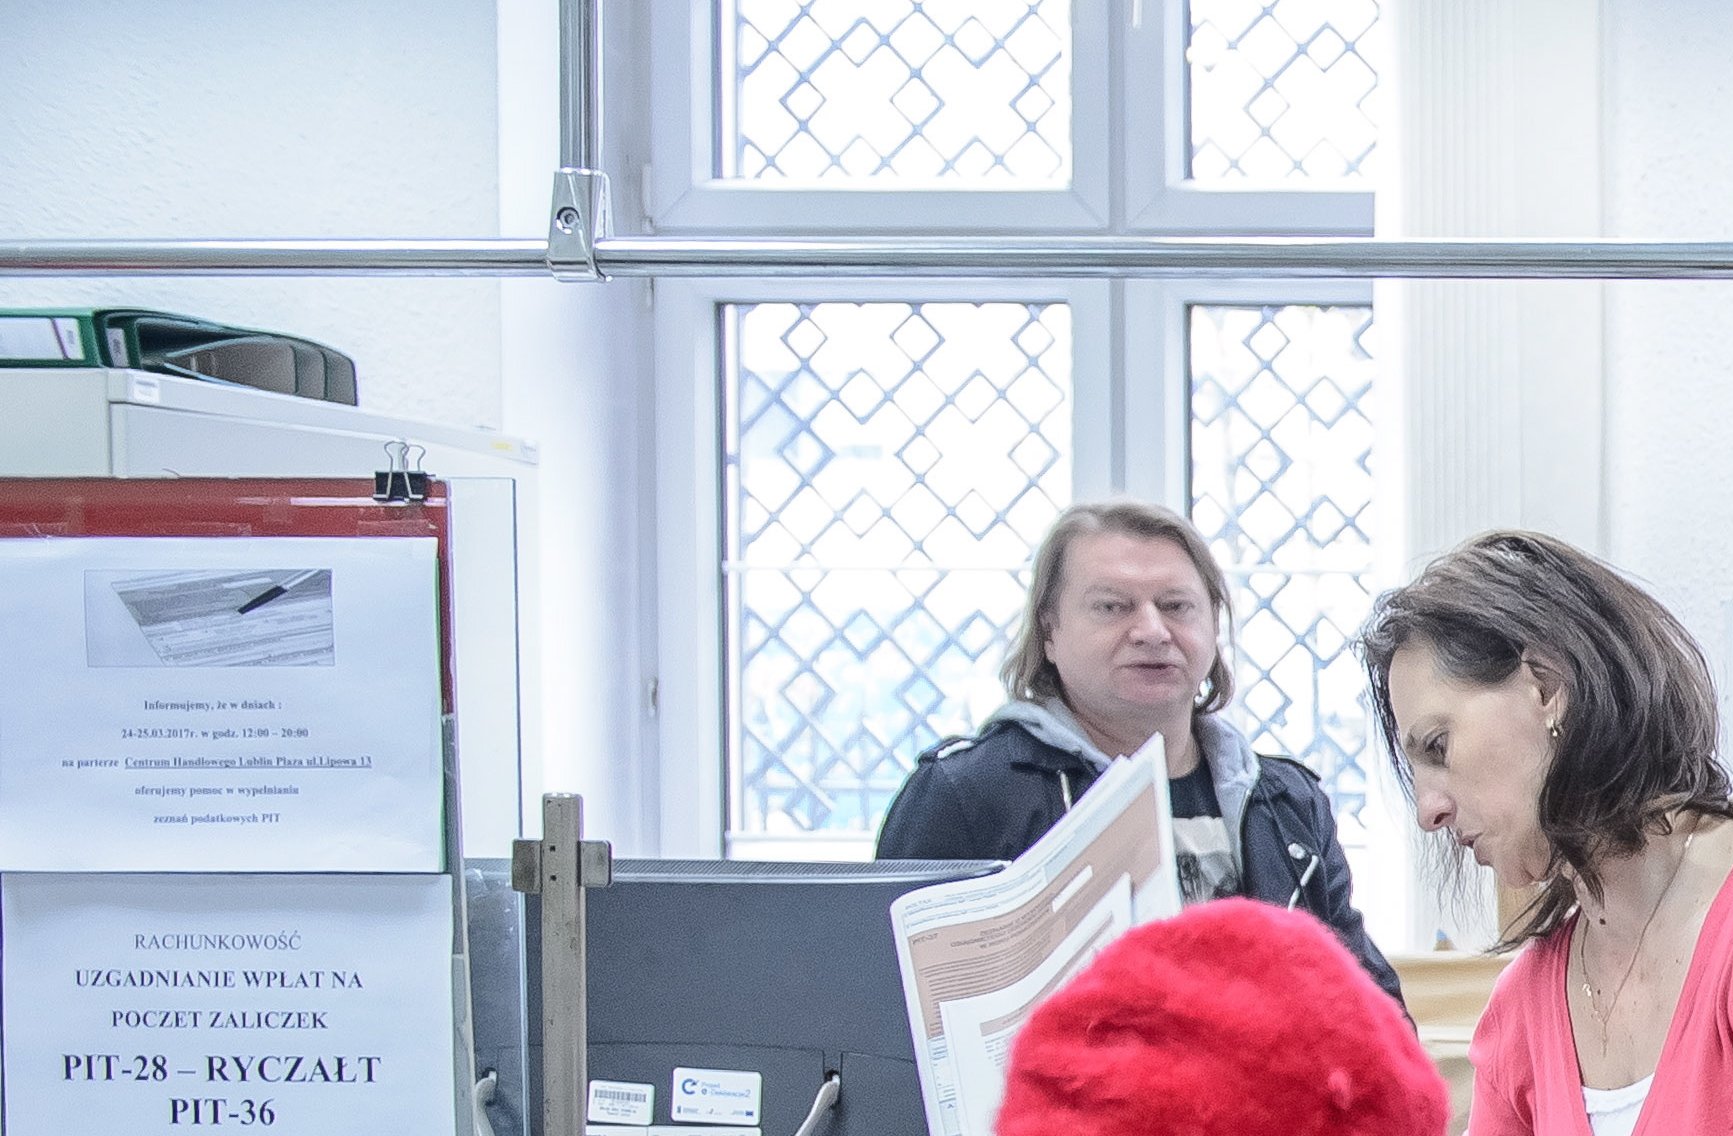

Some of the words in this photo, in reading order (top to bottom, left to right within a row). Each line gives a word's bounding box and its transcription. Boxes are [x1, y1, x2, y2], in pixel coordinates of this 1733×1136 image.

[144, 700, 215, 712] Informujemy,
[230, 702, 238, 710] w
[241, 699, 275, 710] dniach
[201, 730, 209, 738] w
[212, 728, 239, 741] godz.
[242, 728, 270, 738] 12:00
[281, 728, 309, 738] 20:00
[62, 759, 75, 768] na
[77, 758, 119, 770] parterze
[125, 756, 170, 770] Centrum
[239, 755, 273, 769] Lublin
[276, 755, 303, 769] Plaza
[360, 755, 372, 768] 13
[135, 785, 187, 798] oferujemy
[189, 786, 223, 798] pomoc
[226, 787, 234, 795] w
[153, 813, 188, 824] zeznań
[190, 812, 259, 826] podatkowych
[261, 812, 281, 824] PIT
[134, 929, 302, 951] RACHUNKOWOŚĆ
[75, 969, 236, 988] UZGADNIANIE
[242, 970, 325, 988] WPŁAT
[332, 971, 363, 989] NA
[112, 1009, 202, 1029] POCZET
[209, 1010, 329, 1030] ZALICZEK
[62, 1053, 169, 1082] PIT-28
[205, 1054, 383, 1084] RYCZAŁT
[169, 1097, 276, 1126] PIT-36
